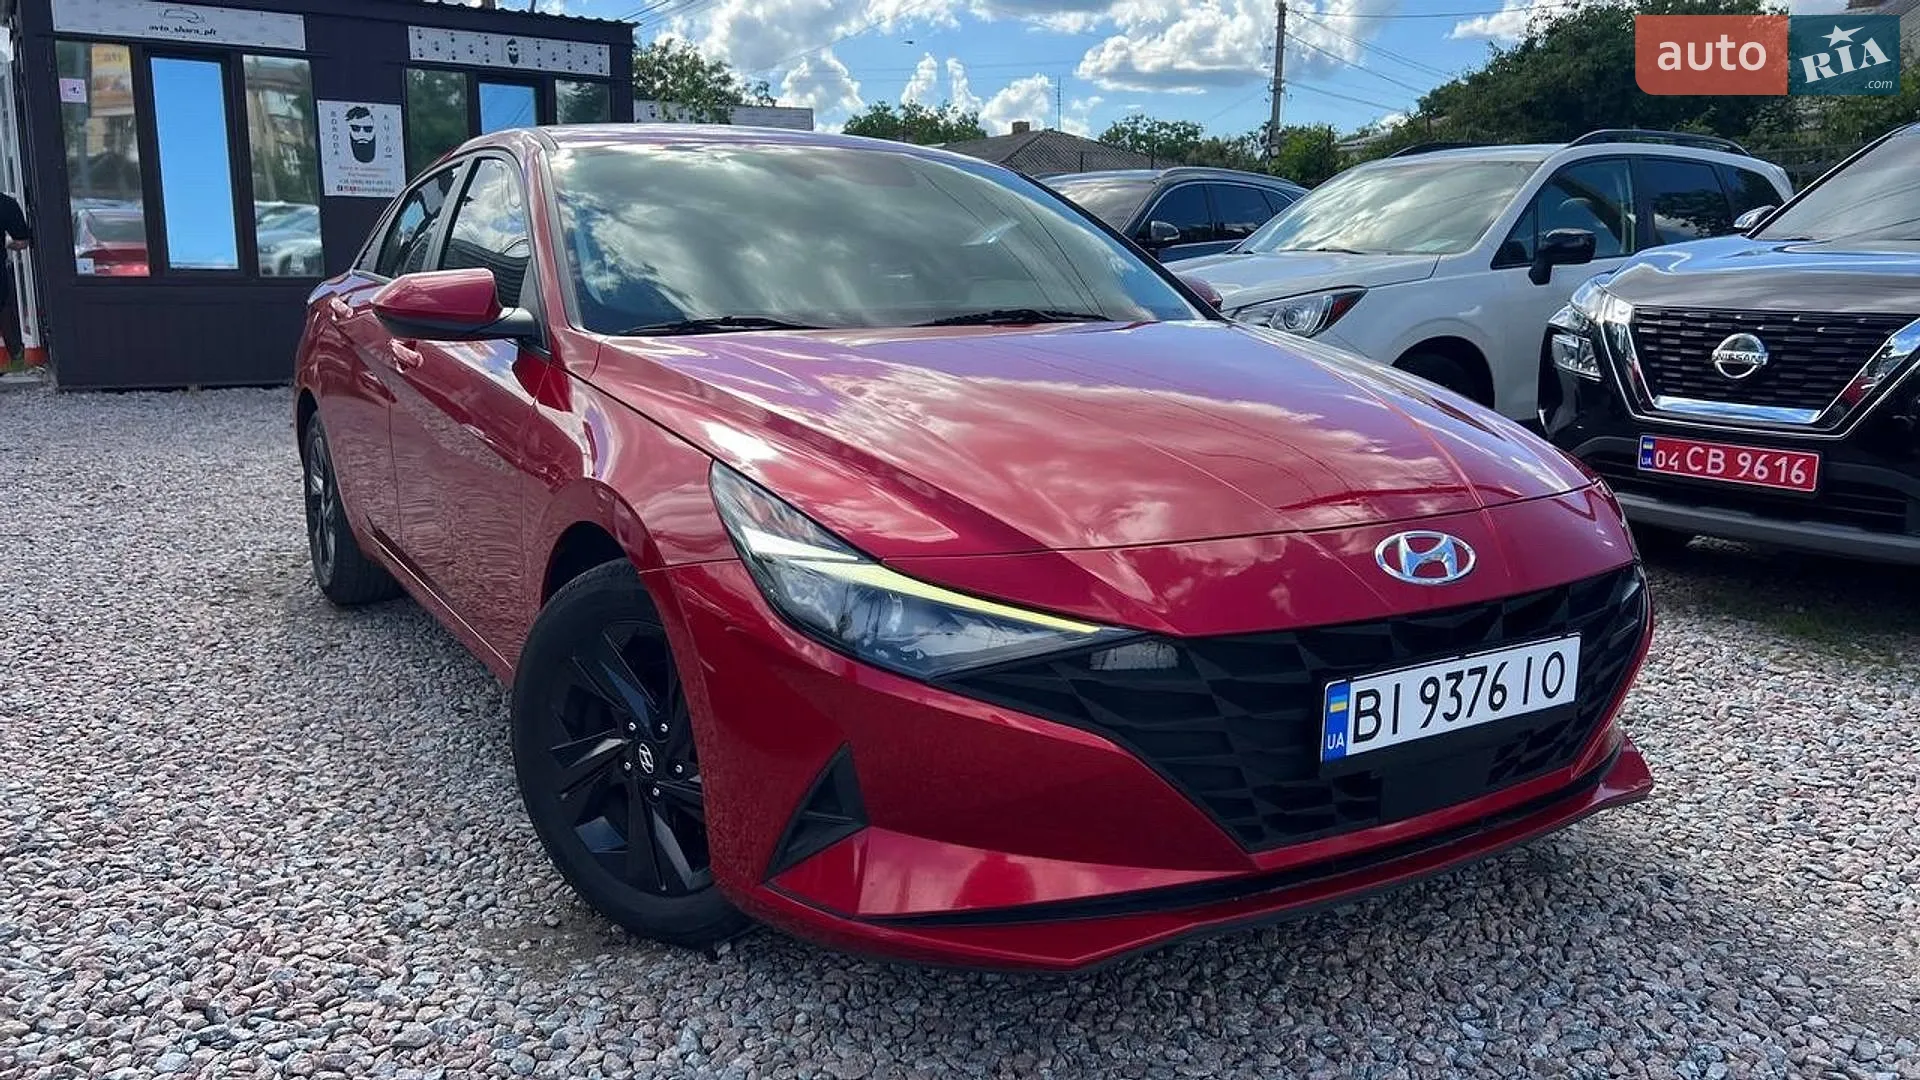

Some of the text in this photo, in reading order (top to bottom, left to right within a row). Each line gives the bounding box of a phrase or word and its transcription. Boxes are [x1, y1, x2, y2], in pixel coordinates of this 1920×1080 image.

[1655, 446, 1806, 484] 04 CB 9616
[1353, 682, 1400, 744] BI
[1420, 661, 1509, 729] 9376
[1327, 732, 1345, 750] UA
